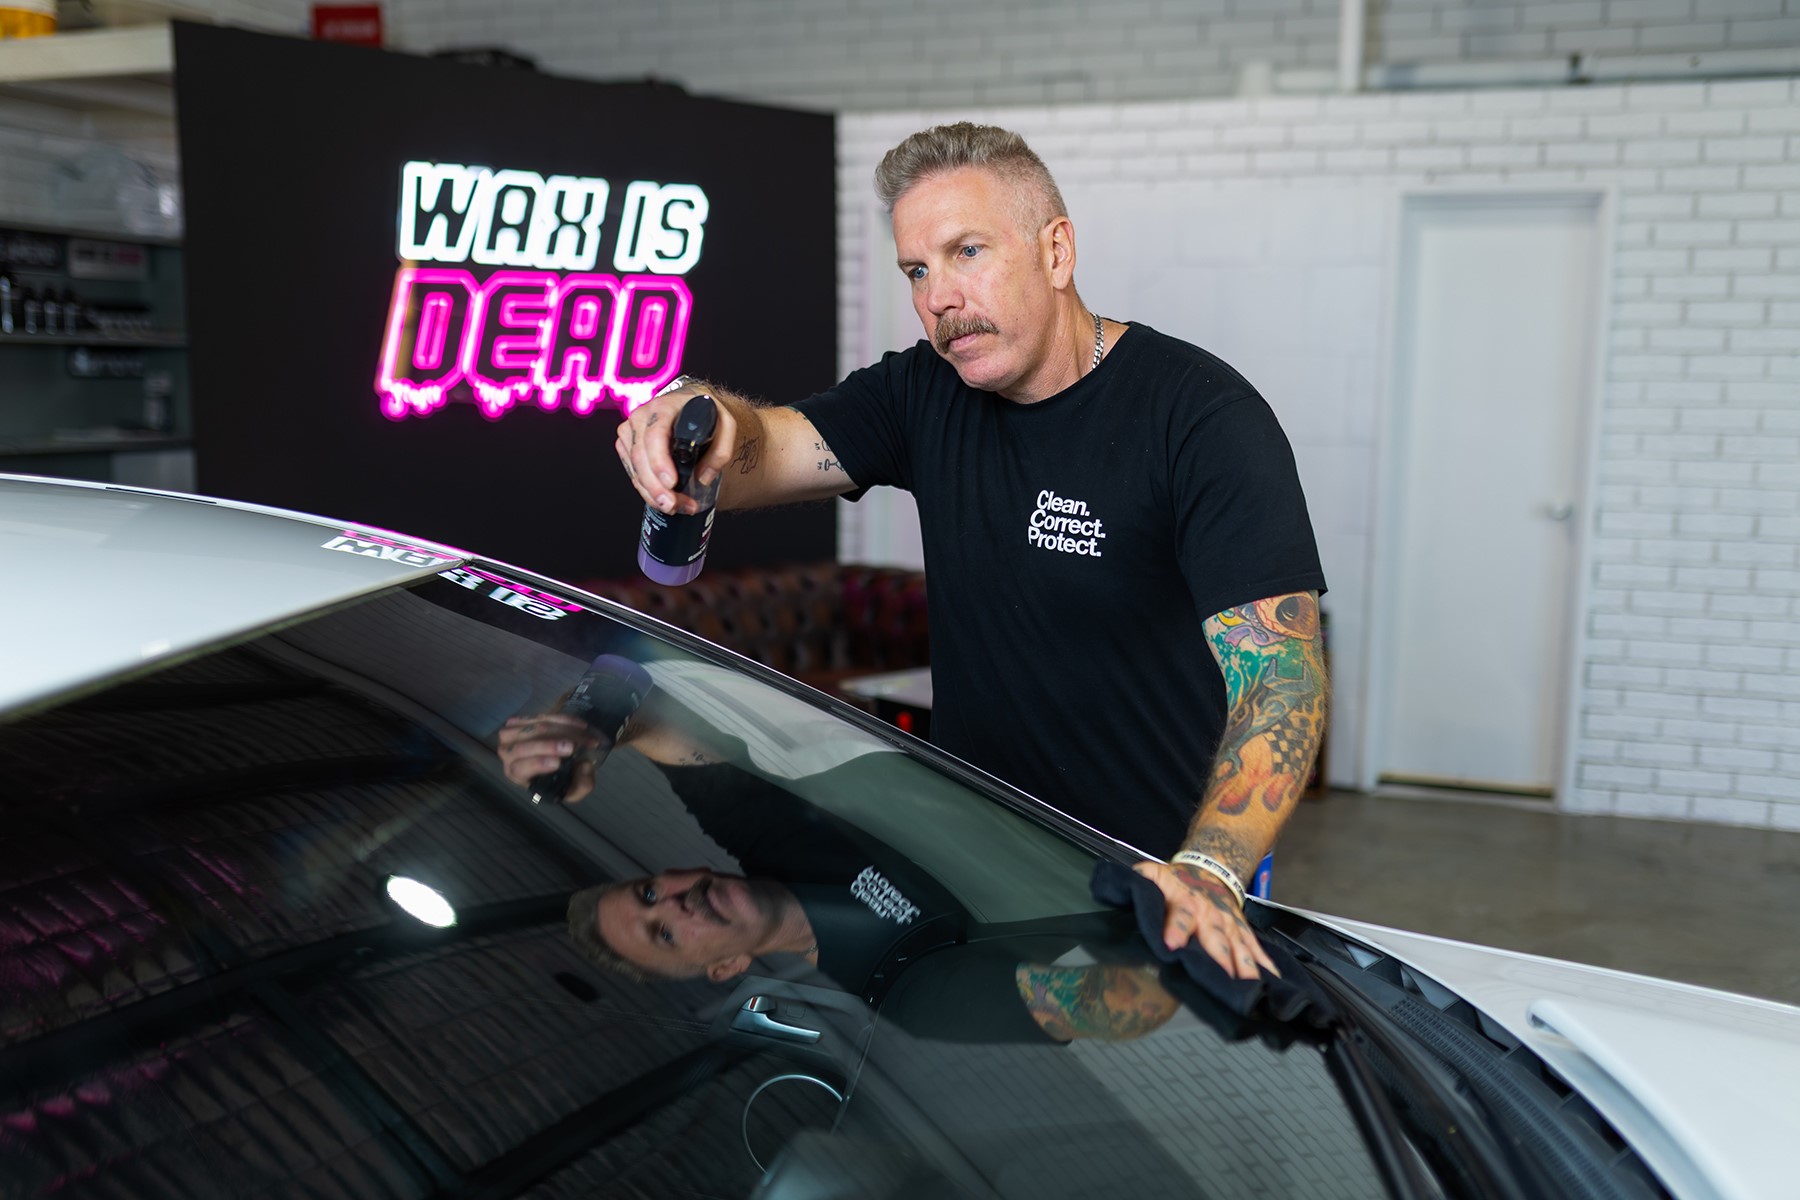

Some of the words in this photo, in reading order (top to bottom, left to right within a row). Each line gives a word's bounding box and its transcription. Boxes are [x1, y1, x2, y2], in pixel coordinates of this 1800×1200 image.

[398, 160, 610, 271] WAX
[613, 180, 709, 275] IS
[374, 268, 694, 420] DEAD
[1036, 489, 1091, 517] Clean.
[1030, 508, 1107, 539] Correct.
[1028, 525, 1102, 557] Protect.
